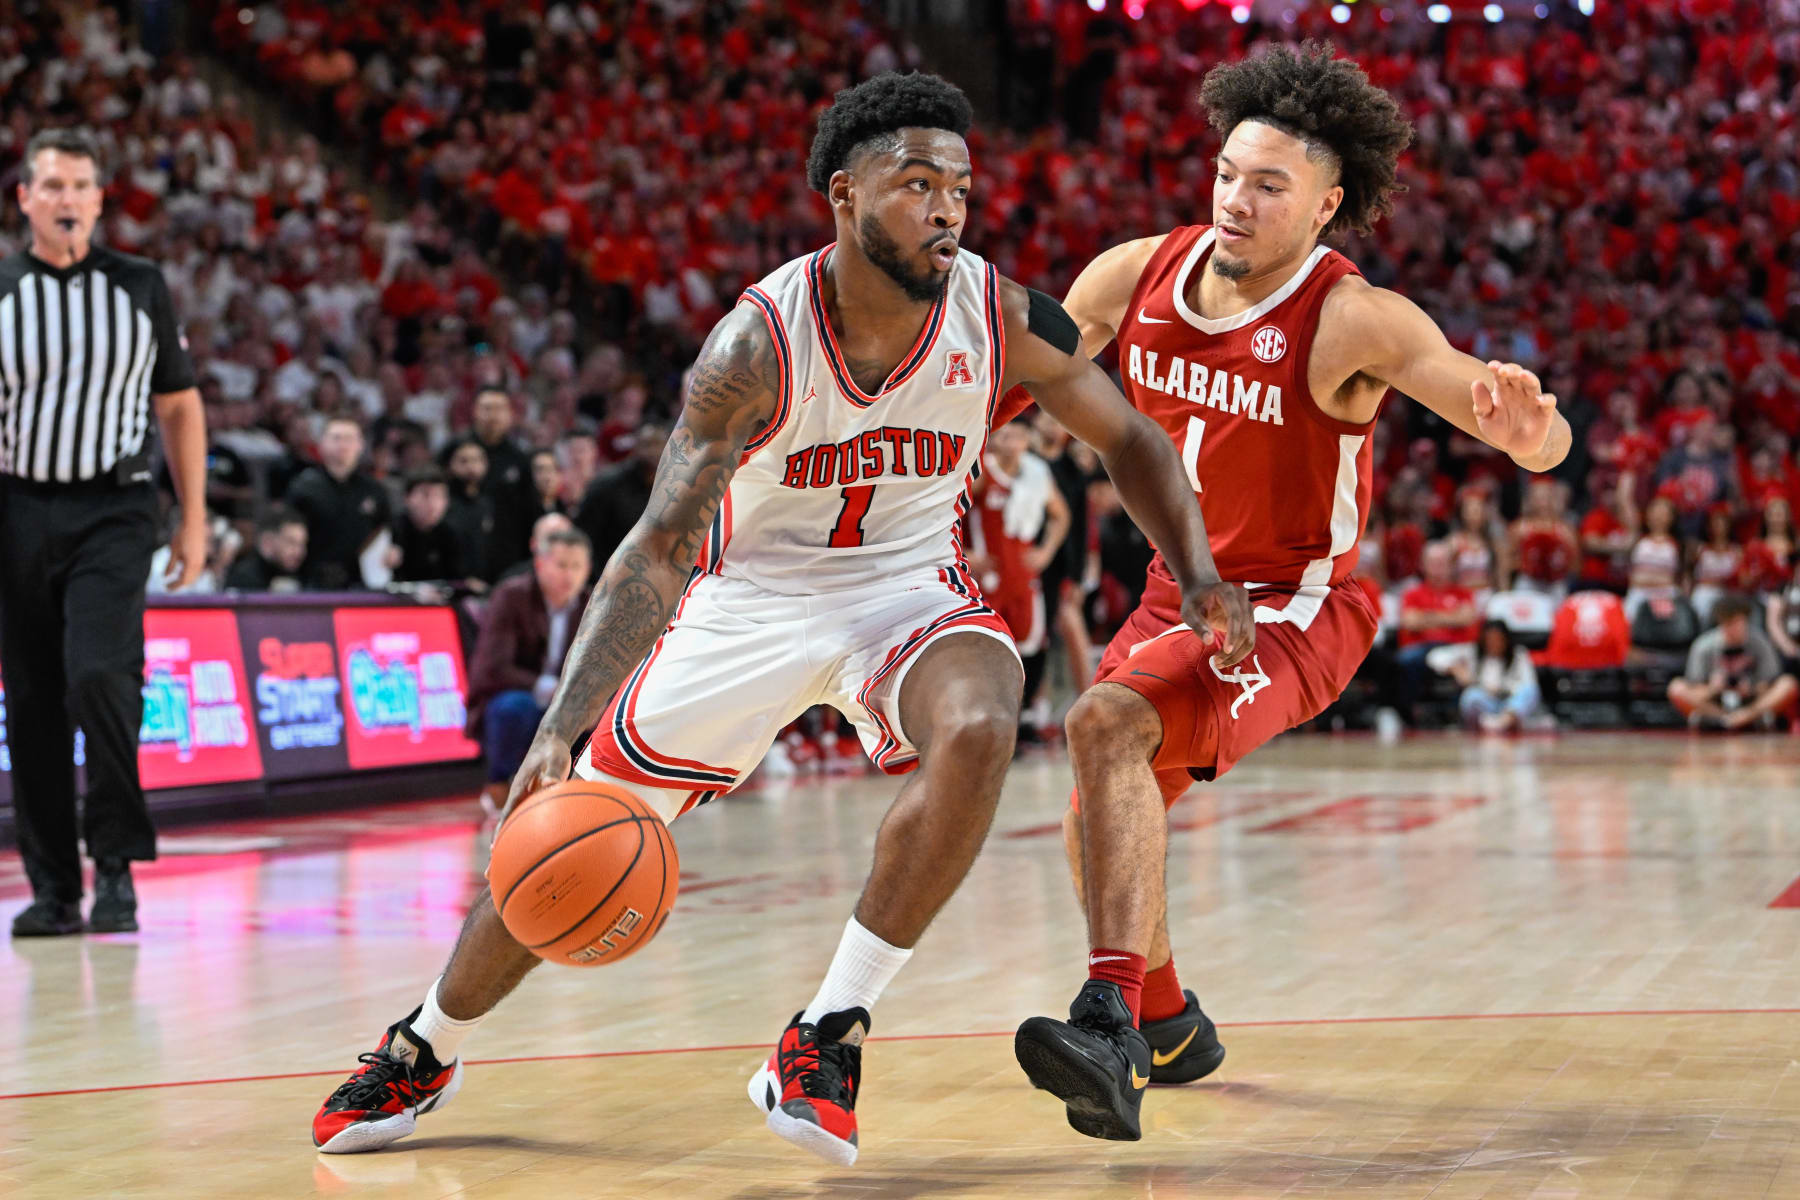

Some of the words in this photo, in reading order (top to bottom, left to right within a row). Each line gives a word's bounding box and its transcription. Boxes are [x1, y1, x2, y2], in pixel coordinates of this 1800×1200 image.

[943, 352, 974, 387] A
[1254, 328, 1284, 360] SEC
[1128, 343, 1284, 426] ALABAMA
[780, 426, 966, 490] HOUSTON
[827, 484, 877, 548] 1
